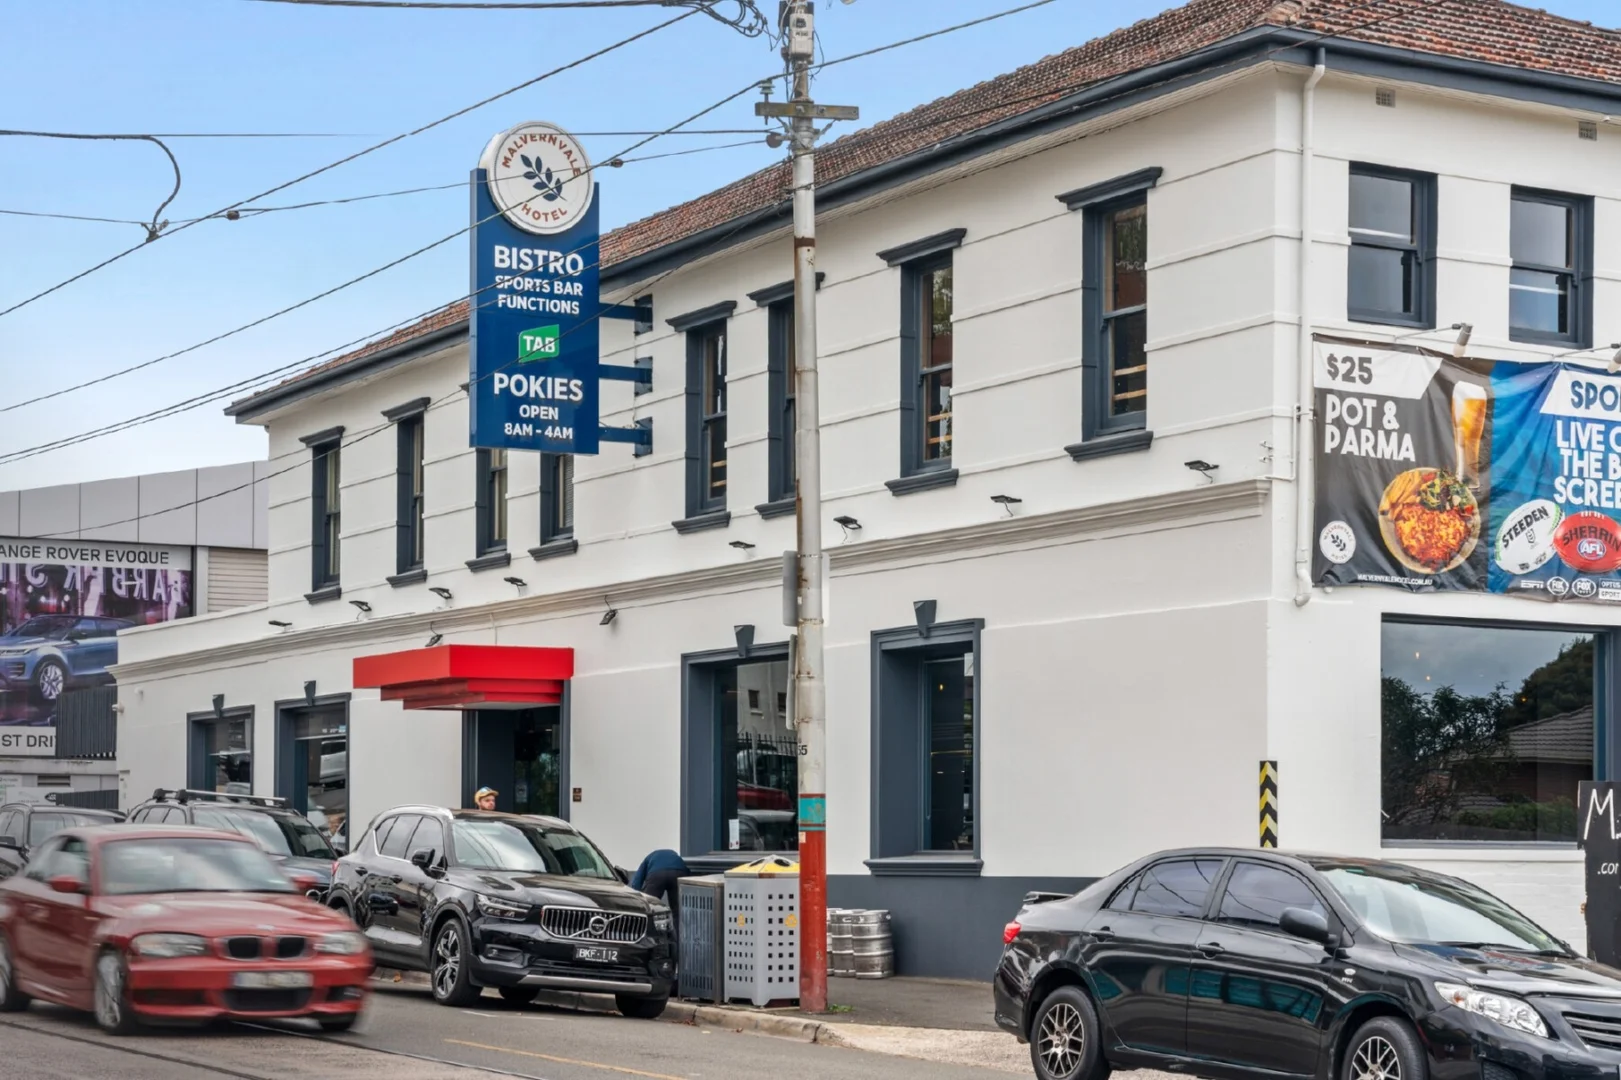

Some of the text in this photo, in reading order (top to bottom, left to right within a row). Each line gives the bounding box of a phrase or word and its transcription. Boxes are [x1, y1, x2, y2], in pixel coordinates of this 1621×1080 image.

[502, 133, 582, 177] MALVERNVALE
[521, 203, 568, 222] HOTEL
[494, 245, 584, 276] BISTRO
[495, 275, 583, 296] SPORTS BAR
[498, 294, 580, 314] FUNCTIONS
[523, 335, 556, 353] TAB
[1326, 353, 1373, 385] $25
[493, 372, 583, 401] POKIES
[1570, 380, 1621, 412] SPO
[519, 404, 559, 420] OPEN
[1325, 393, 1400, 430] POT &
[504, 422, 533, 436] 8AM
[544, 425, 573, 439] 4AM
[1324, 424, 1416, 462] PARMA
[1556, 419, 1605, 452] LIVE
[1560, 447, 1603, 479] THE
[1502, 505, 1550, 548] STEEDEN
[1562, 525, 1621, 552] SHERRIN
[46, 547, 100, 562] ROVER
[105, 550, 169, 565] EVOQUE
[1580, 542, 1604, 555] AFL
[1, 734, 56, 747] ST DRI
[1583, 788, 1621, 840] M
